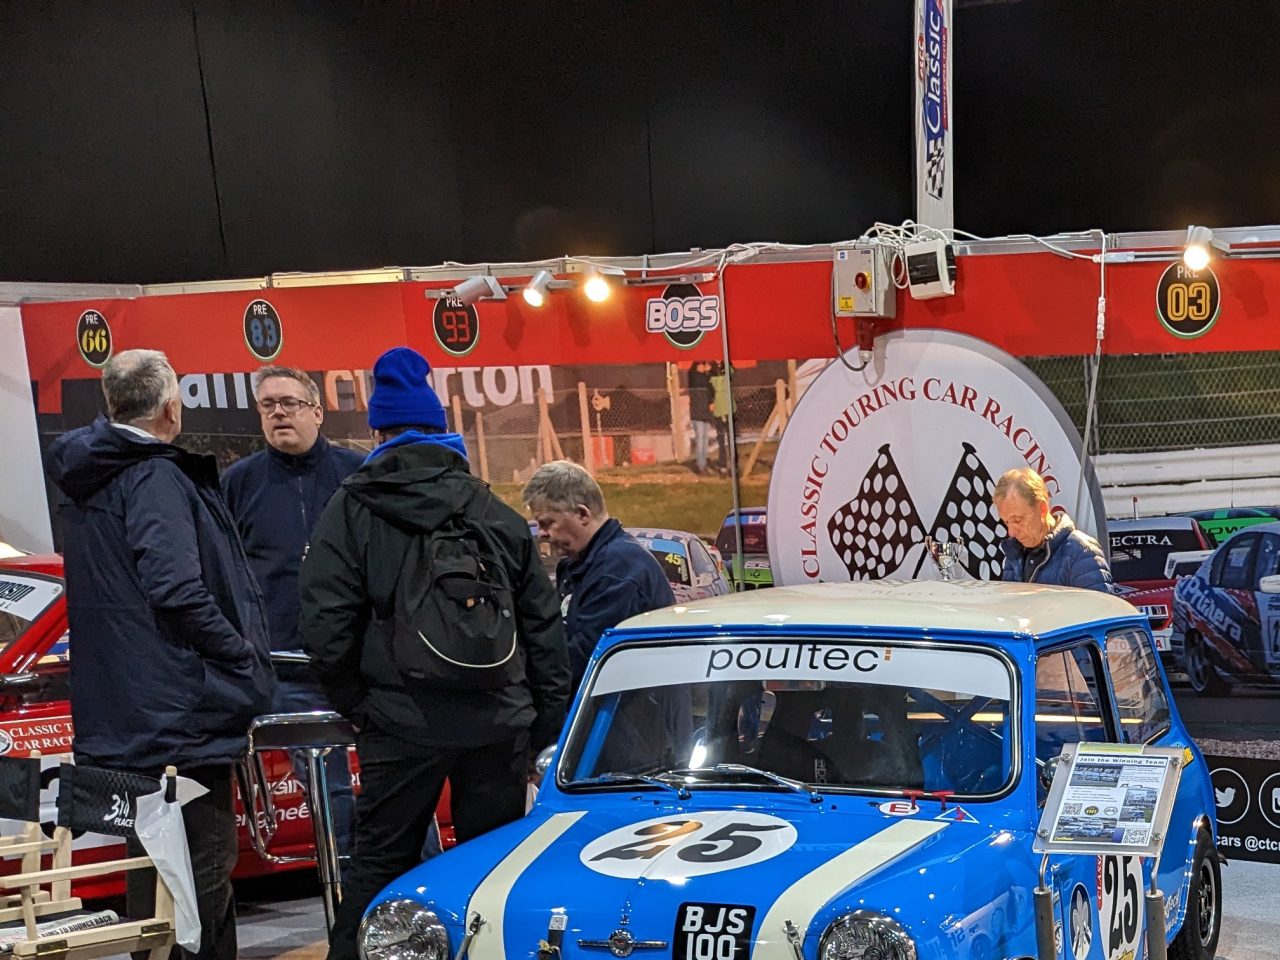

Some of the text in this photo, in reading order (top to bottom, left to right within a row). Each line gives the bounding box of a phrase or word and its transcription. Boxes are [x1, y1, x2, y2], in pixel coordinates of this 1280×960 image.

[927, 11, 940, 134] Classic
[1177, 264, 1200, 280] PRE
[253, 304, 267, 315] PRE
[446, 297, 463, 308] PRE
[649, 299, 717, 331] BOSS
[1167, 282, 1211, 322] 03
[85, 314, 99, 325] PRE
[442, 311, 469, 342] 93
[82, 329, 107, 353] 66
[802, 377, 1061, 579] CLASSIC TOURING CAR RACING
[1110, 535, 1173, 547] ECTRA
[664, 553, 681, 565] 45
[706, 644, 879, 678] poultec
[10, 723, 61, 738] CLASSIC
[13, 739, 42, 751] CAR
[104, 791, 131, 821] 3rd
[114, 817, 135, 828] PLACE
[588, 820, 788, 863] 25
[682, 905, 747, 934] BJS
[1104, 855, 1139, 959] 25
